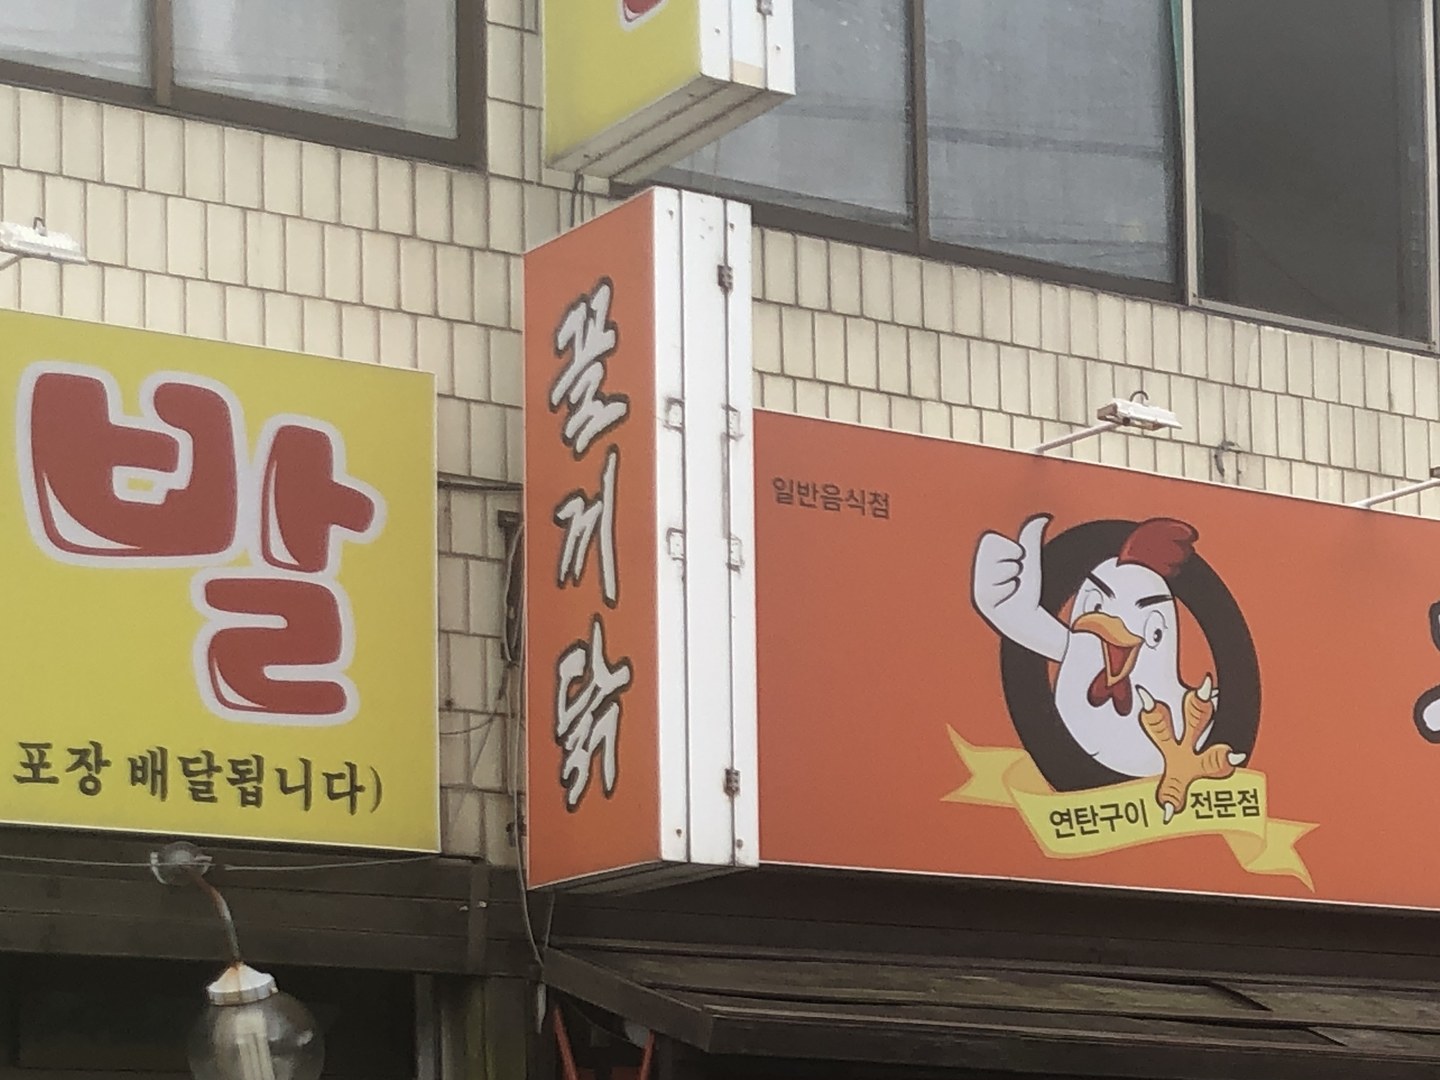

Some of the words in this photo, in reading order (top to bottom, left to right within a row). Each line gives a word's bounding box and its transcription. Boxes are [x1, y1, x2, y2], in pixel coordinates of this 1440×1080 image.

[771, 476, 889, 519] 일반음식점
[20, 363, 385, 722] 발
[13, 740, 112, 797] 포장
[127, 745, 384, 815] 배달됩니다)
[1049, 798, 1149, 839] 연탄구이
[1190, 788, 1261, 820] 전문점
